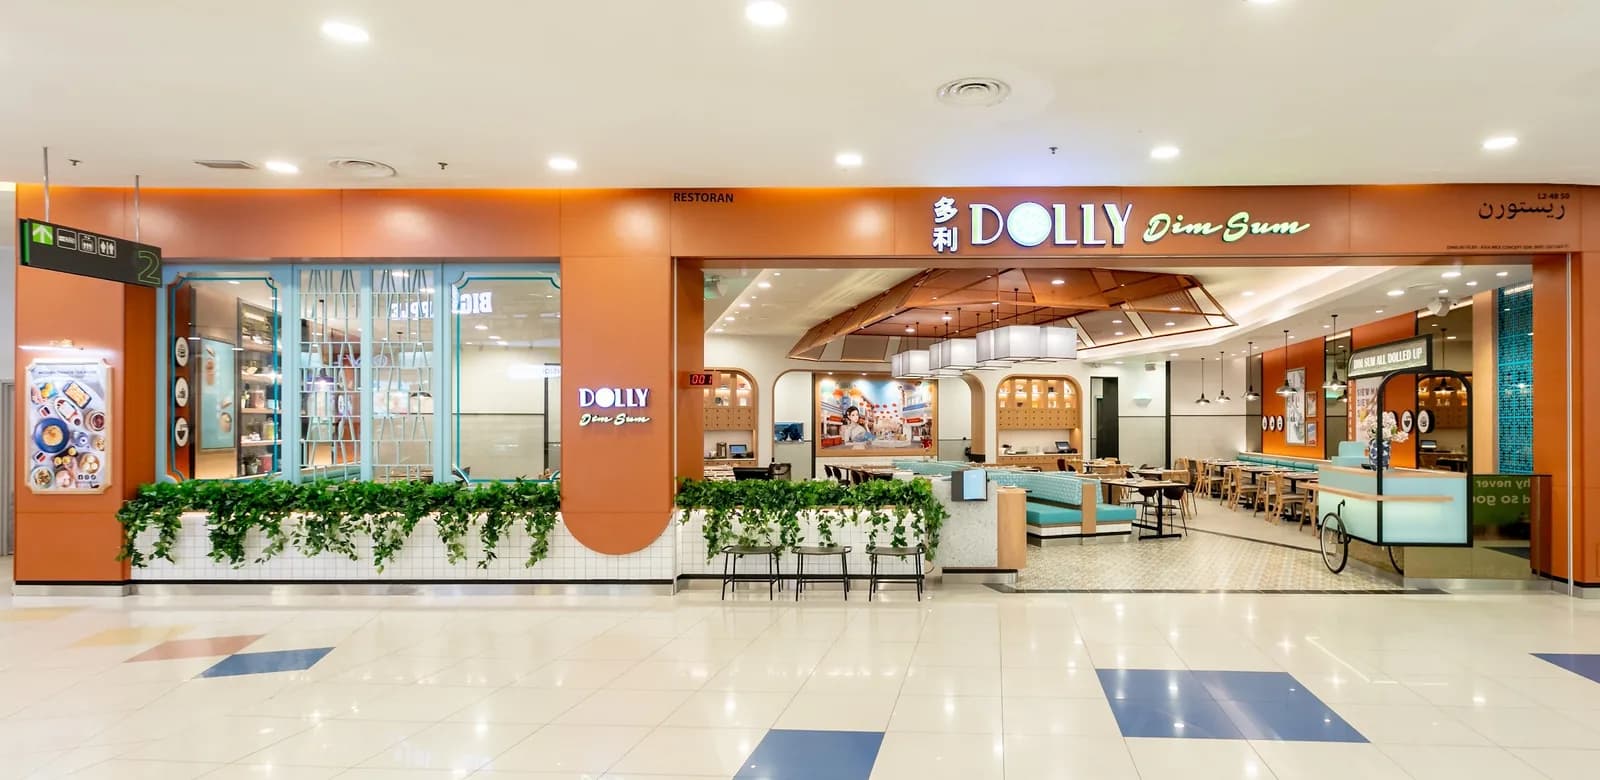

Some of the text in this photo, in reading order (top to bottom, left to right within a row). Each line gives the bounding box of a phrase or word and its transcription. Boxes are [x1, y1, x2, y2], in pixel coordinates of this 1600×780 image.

[673, 192, 734, 203] RESTORAN
[1479, 202, 1565, 220] ريستورن
[933, 196, 959, 252] 多利
[969, 202, 1311, 247] DOLLY Dim Sum
[137, 250, 161, 285] 2
[1376, 354, 1387, 365] ALL
[1387, 349, 1411, 363] DOLLED
[1412, 347, 1422, 359] UP
[692, 374, 712, 385] 001
[579, 388, 649, 408] DOLLY
[579, 413, 650, 426] Dim Sum
